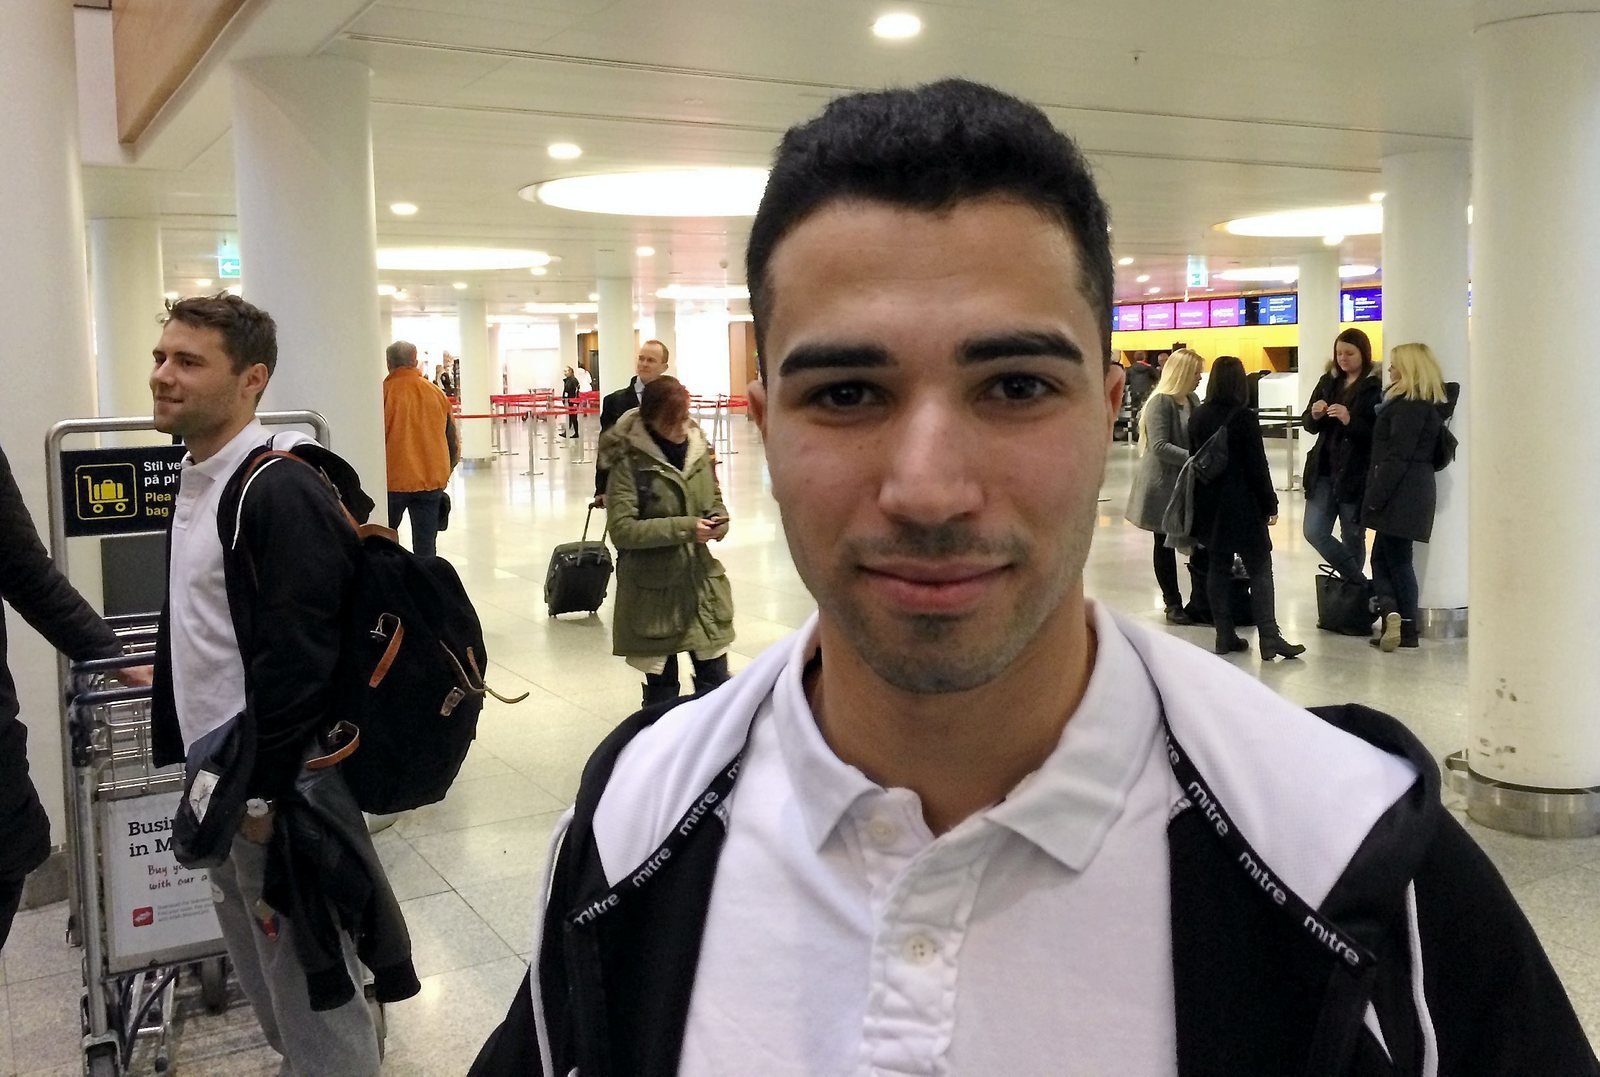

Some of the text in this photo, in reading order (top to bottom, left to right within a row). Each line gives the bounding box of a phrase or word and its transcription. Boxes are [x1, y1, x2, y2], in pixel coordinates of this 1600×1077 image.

[143, 461, 163, 471] Stil
[144, 473, 178, 487] på pl
[145, 492, 171, 502] Plea
[145, 506, 169, 517] bag
[129, 843, 149, 857] in
[573, 893, 620, 926] mitre
[632, 847, 672, 888] mitre
[679, 791, 719, 836] mitre
[148, 865, 167, 876] Buy
[1188, 781, 1229, 837] mitre
[1238, 852, 1287, 905] mitre
[1304, 915, 1360, 966] mitre
[149, 879, 171, 890] with
[178, 877, 194, 886] our
